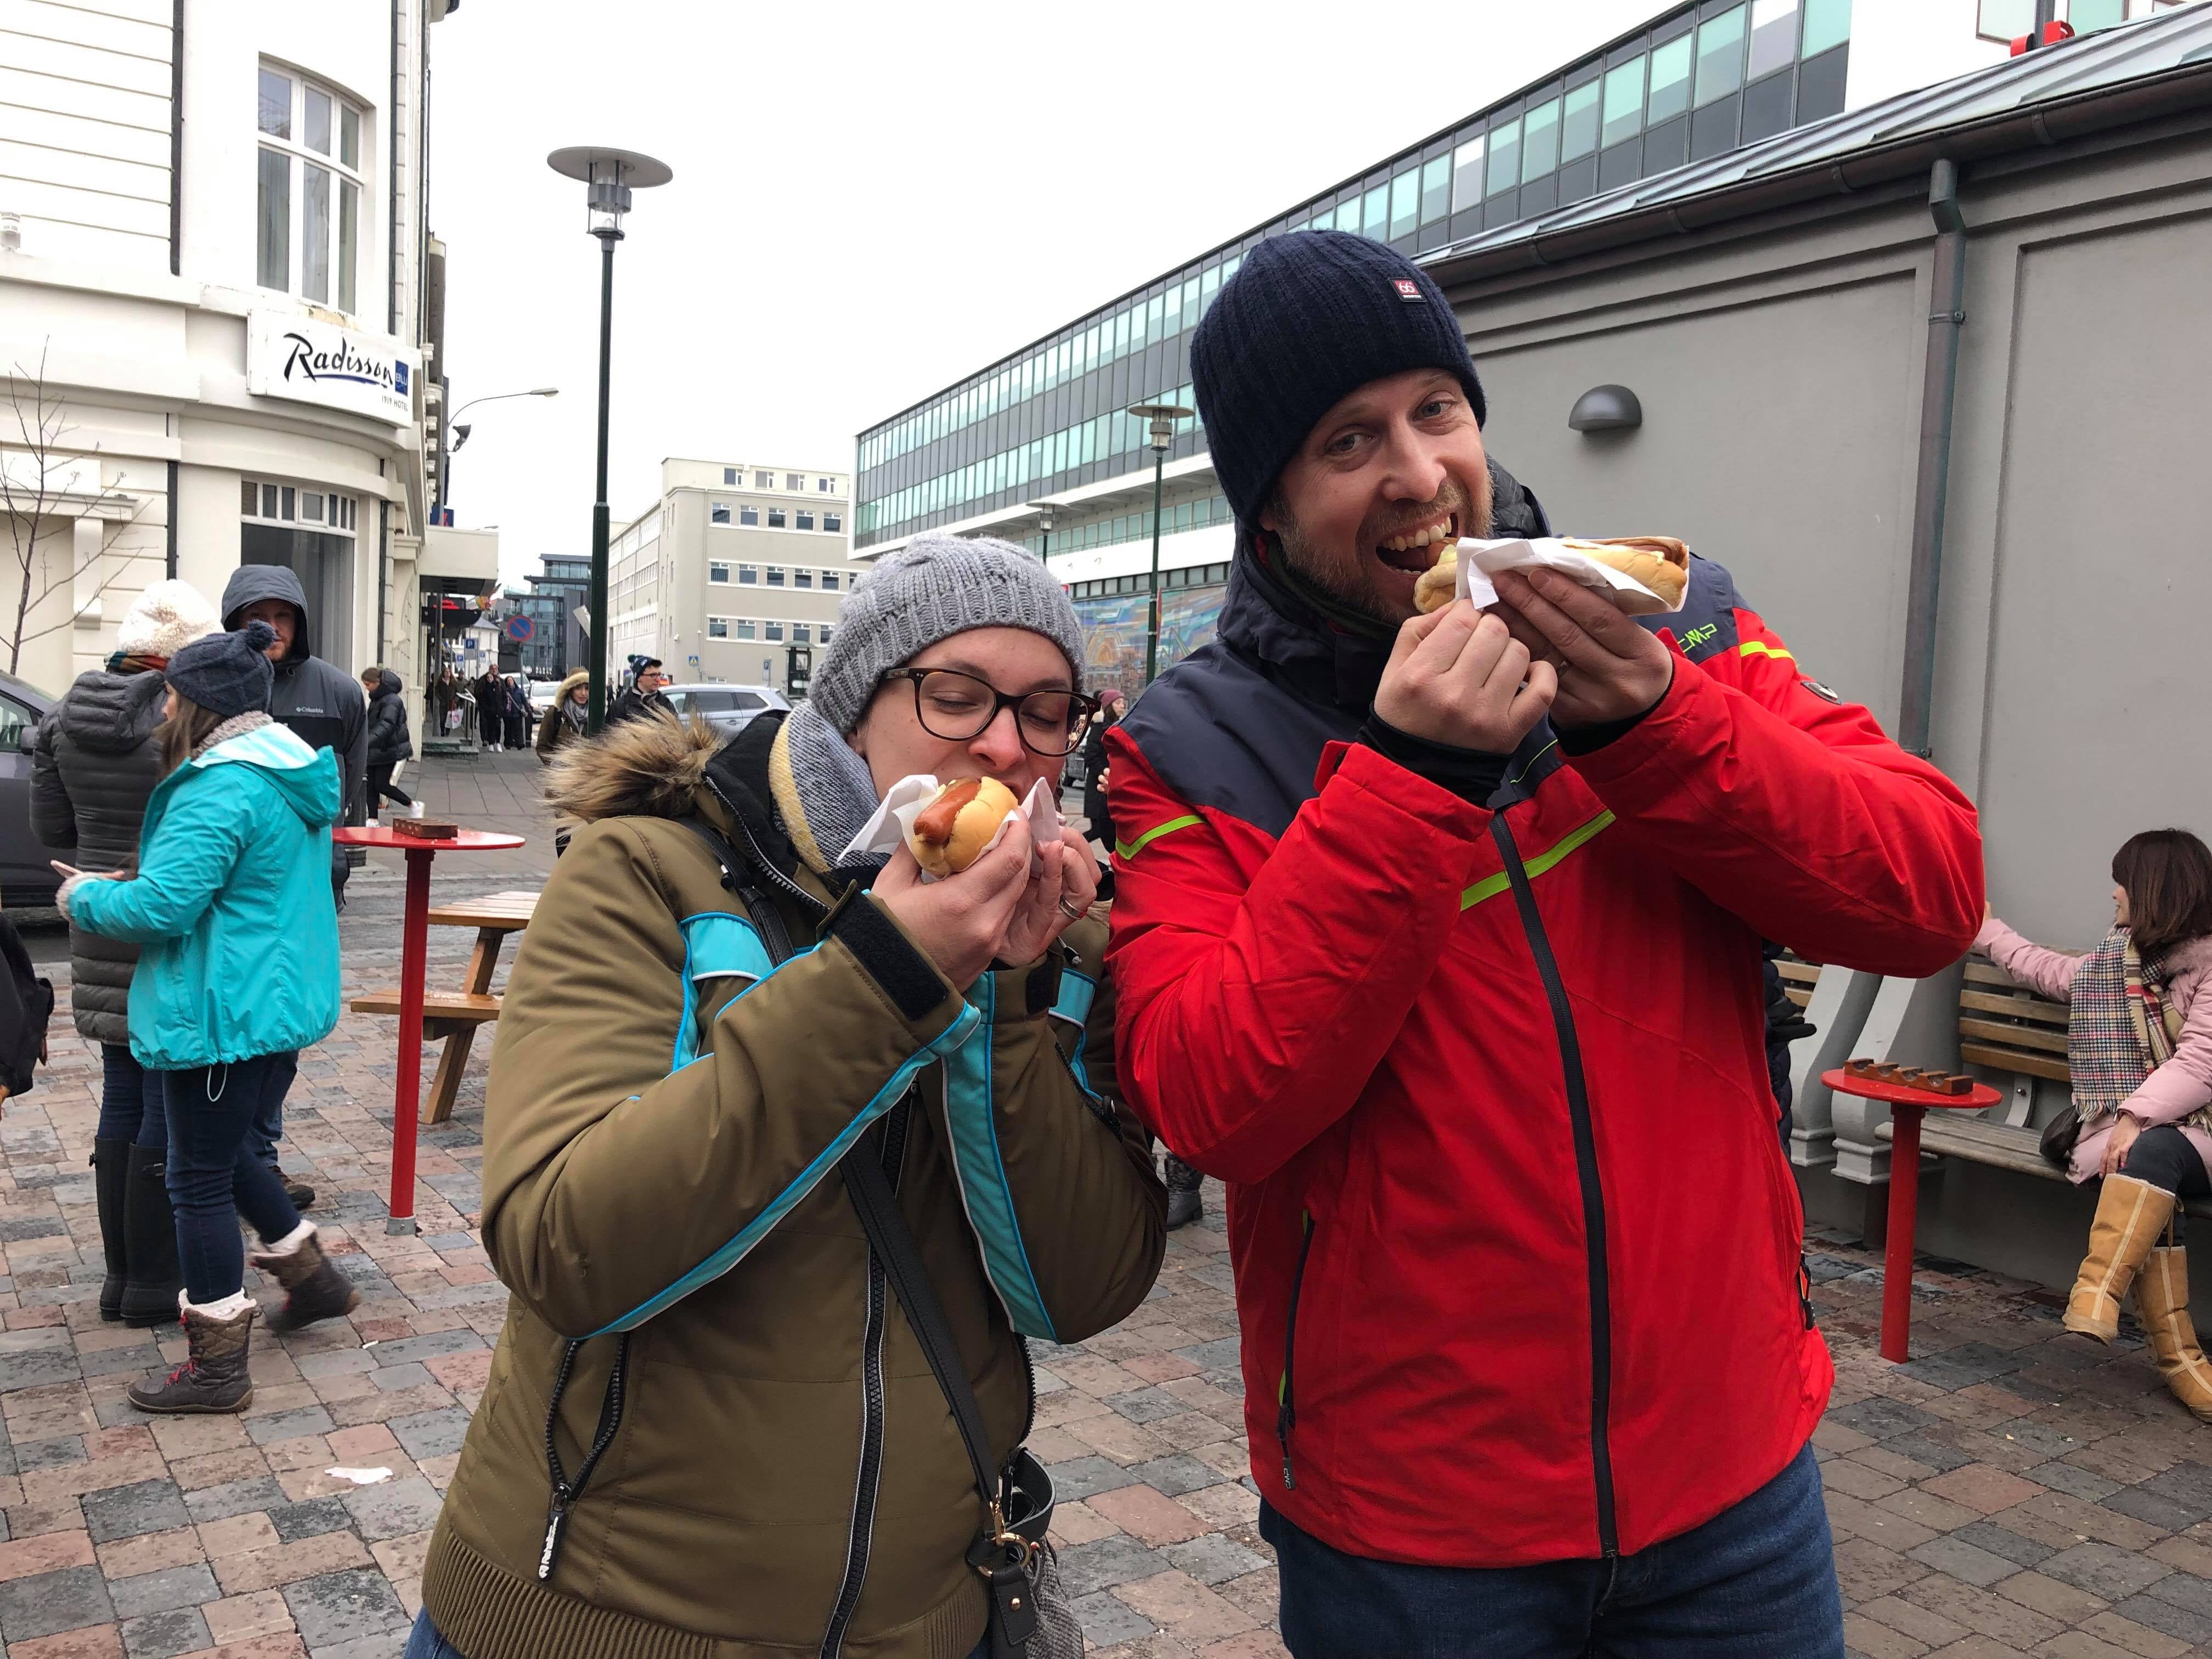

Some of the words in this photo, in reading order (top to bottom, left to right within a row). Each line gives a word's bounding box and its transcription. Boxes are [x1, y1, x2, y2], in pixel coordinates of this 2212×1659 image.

[283, 332, 393, 385] Radisson
[396, 372, 408, 386] BLU
[382, 395, 392, 404] 1919
[394, 399, 408, 411] HOTEL
